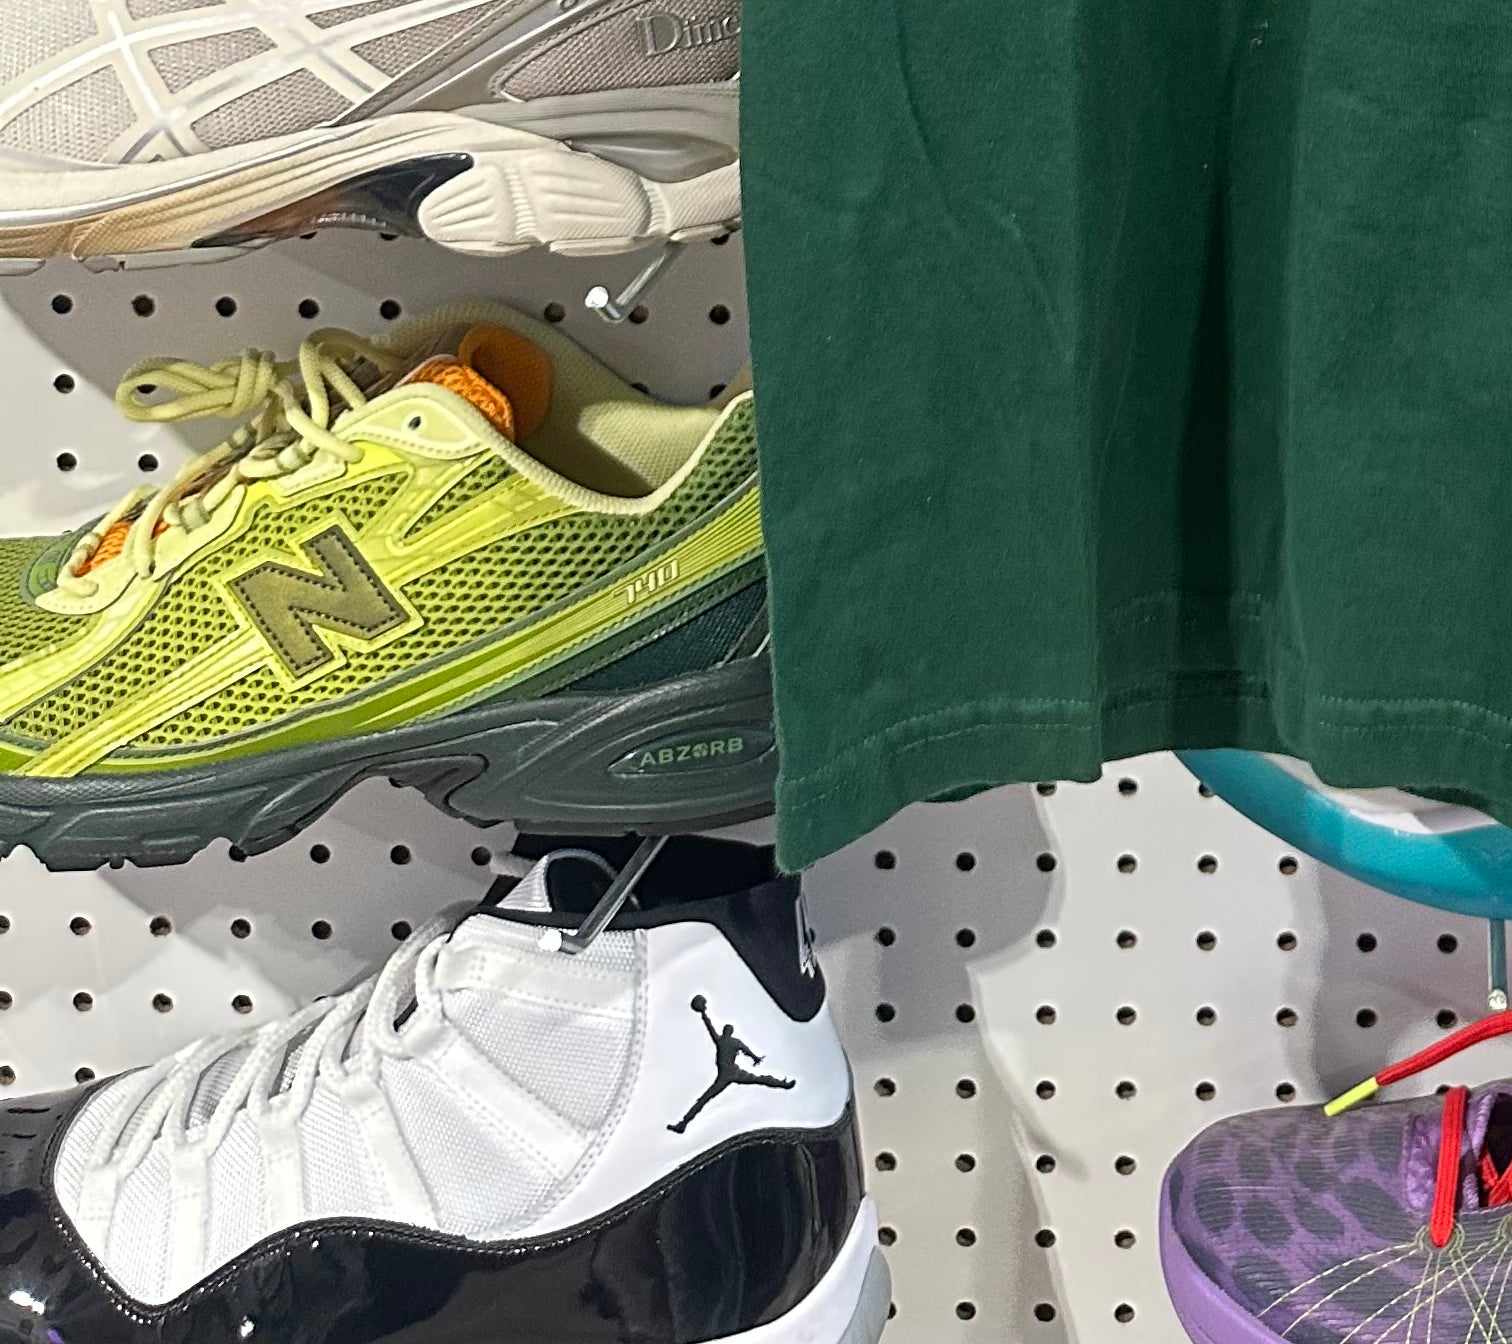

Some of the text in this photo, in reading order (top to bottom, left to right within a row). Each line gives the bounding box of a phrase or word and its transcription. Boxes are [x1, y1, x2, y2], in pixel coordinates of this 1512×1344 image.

[225, 523, 411, 679] N
[613, 559, 679, 604] 740
[640, 737, 744, 767] ABZORB
